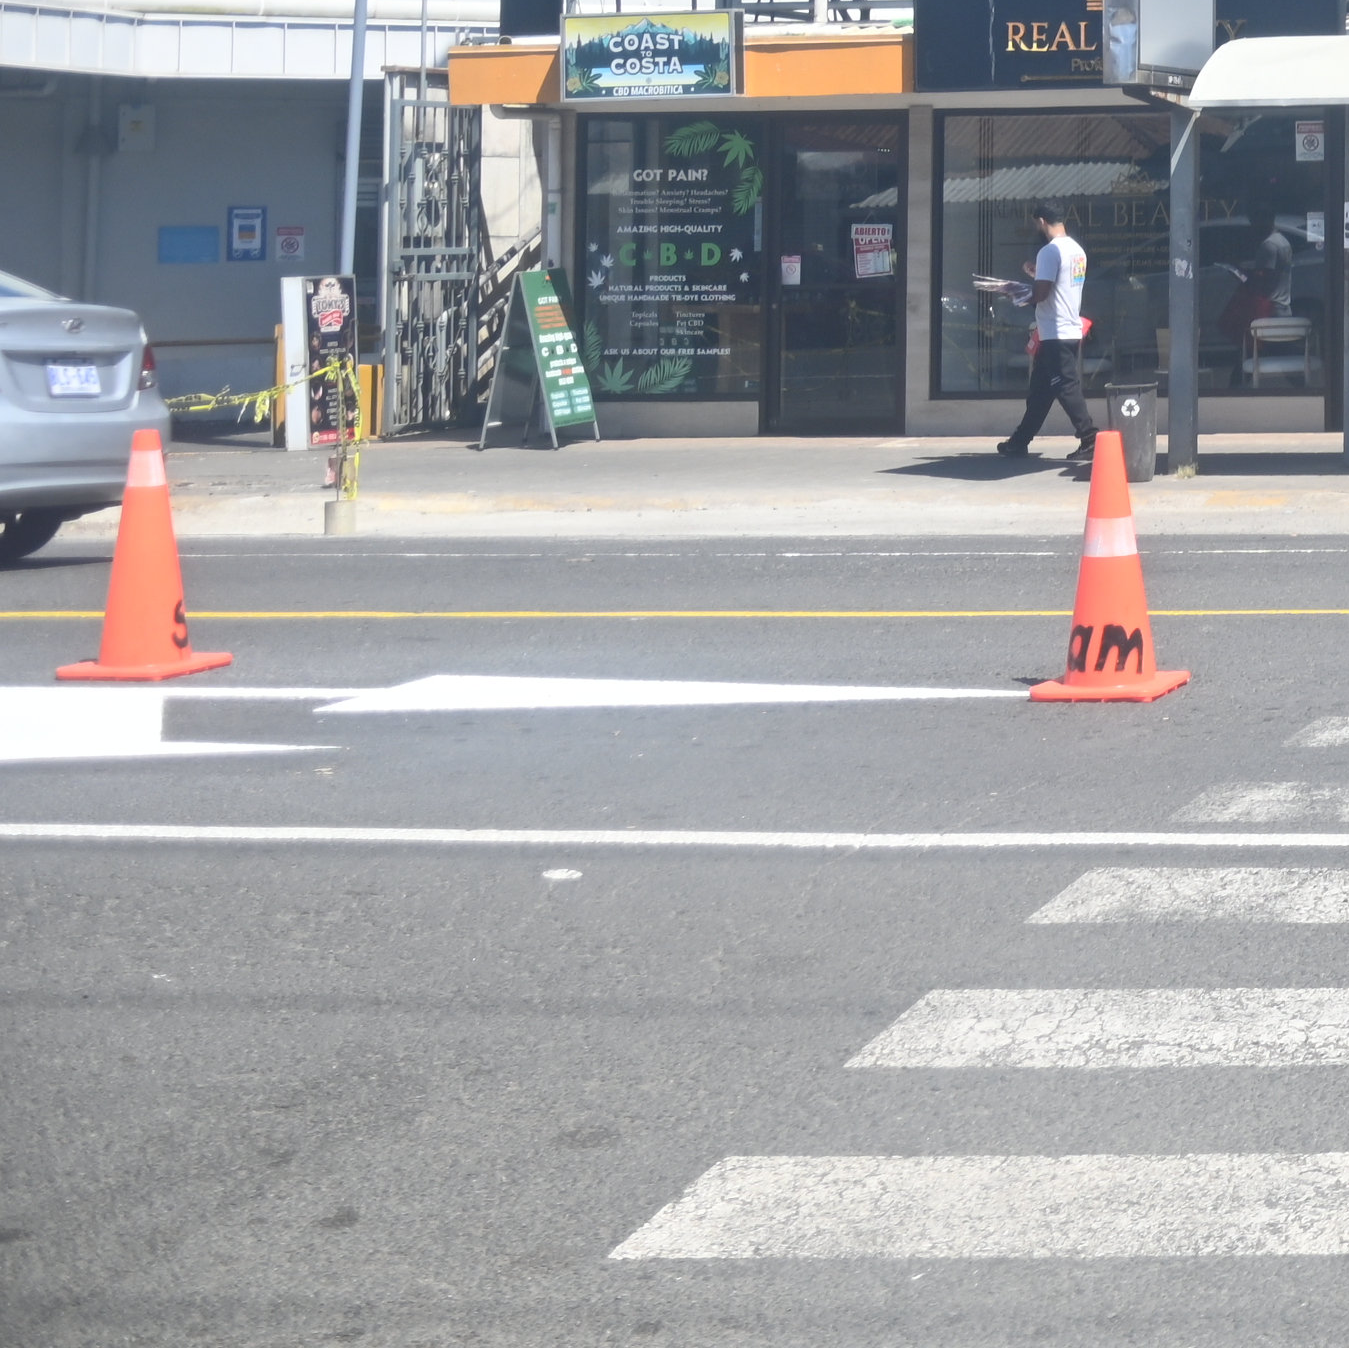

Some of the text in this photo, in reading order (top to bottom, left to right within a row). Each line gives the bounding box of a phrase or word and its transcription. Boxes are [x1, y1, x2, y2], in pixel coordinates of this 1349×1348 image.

[609, 32, 683, 53] COAST
[1005, 21, 1097, 52] REAL
[610, 56, 684, 75] COSTA
[613, 85, 683, 96] CBD MACROBITICA
[633, 168, 709, 182] GOT PAIN?
[1113, 200, 1238, 227] BEATY
[617, 224, 723, 234] AMAZING HIGH-QUALITY
[599, 294, 626, 303] UNIQUE
[697, 347, 731, 355] SAMPLES!
